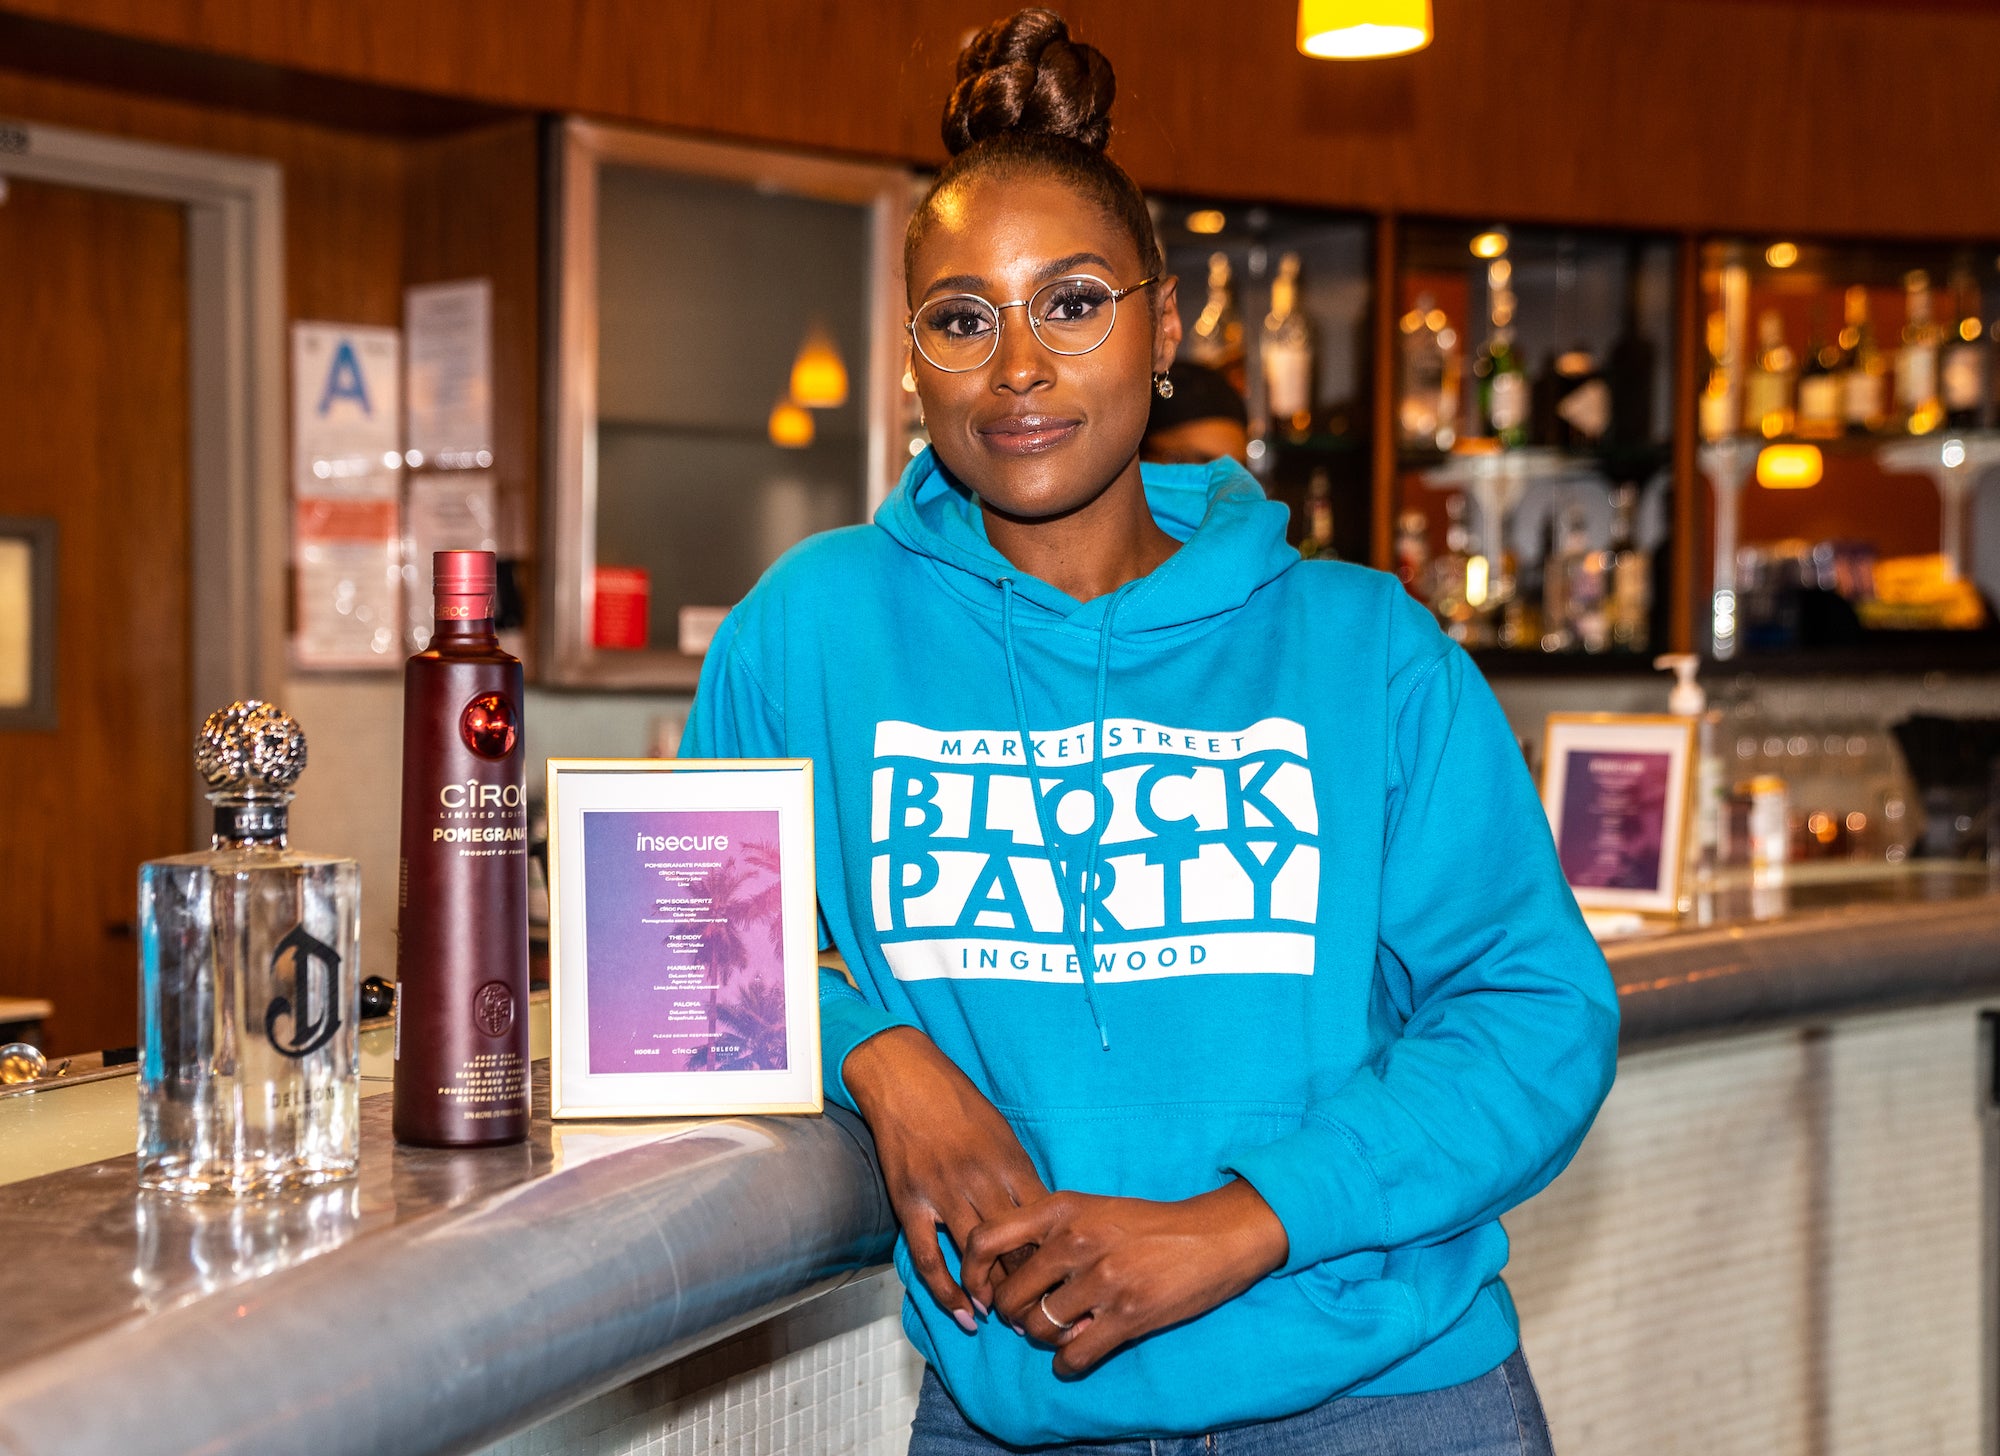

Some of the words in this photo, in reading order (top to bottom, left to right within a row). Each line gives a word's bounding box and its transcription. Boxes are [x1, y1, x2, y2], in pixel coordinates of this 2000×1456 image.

[318, 336, 372, 420] A
[940, 733, 1086, 758] MARKET
[1108, 727, 1245, 754] STREET
[439, 811, 495, 819] LIMITED
[889, 760, 1299, 847] BLOCK
[459, 849, 496, 857] PRODUCT
[636, 832, 729, 851] insecure
[889, 842, 1299, 933] PARTY
[962, 945, 1207, 975] INGLEWOOD
[437, 1086, 503, 1095] POMEGRANATE
[456, 1095, 497, 1103] NATURAL
